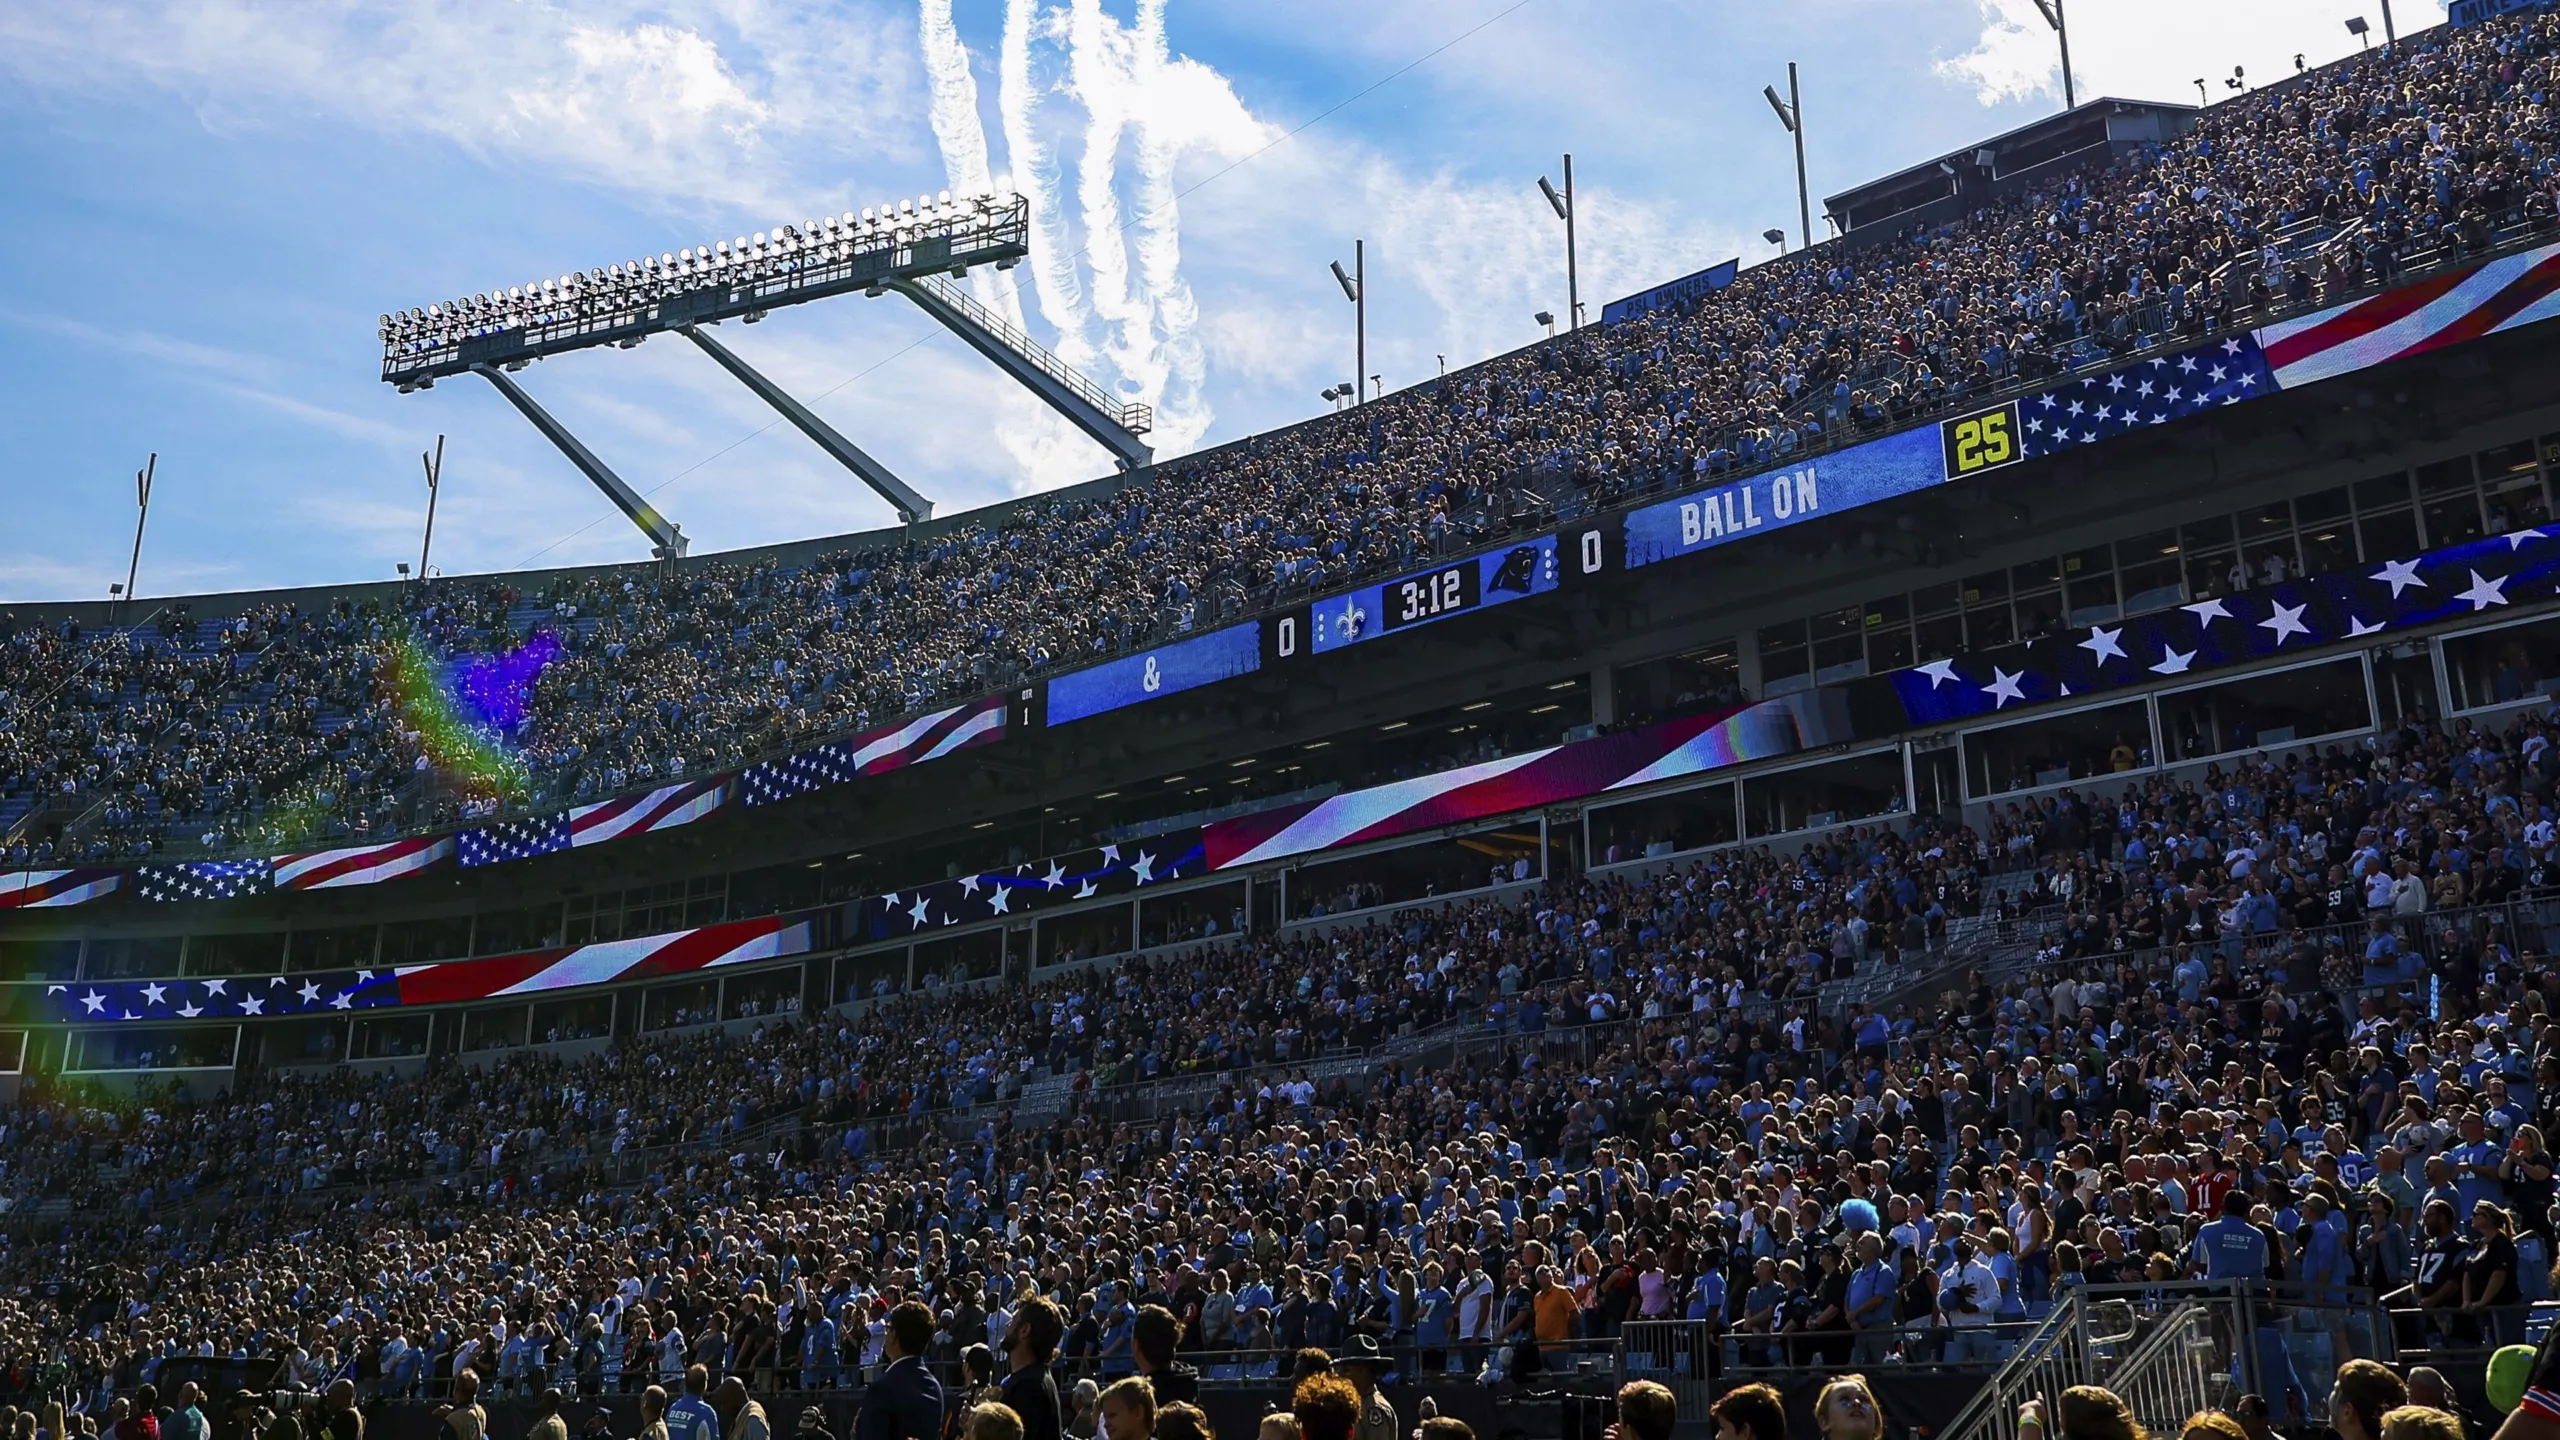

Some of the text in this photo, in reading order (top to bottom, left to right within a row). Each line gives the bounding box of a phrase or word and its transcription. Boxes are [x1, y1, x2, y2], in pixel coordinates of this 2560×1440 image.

[1626, 275, 1710, 316] PSL OWNERS
[1956, 412, 2009, 471] 25
[1680, 468, 1817, 545] BALL ON
[1582, 530, 1601, 573] 0
[1399, 567, 1460, 621] 3:12
[1279, 618, 1295, 657] 0
[1144, 657, 1160, 692] &
[1022, 689, 1032, 700] QTR
[1024, 707, 1028, 725] 1
[2228, 794, 2235, 806] 8
[2530, 830, 2539, 842] 4
[2328, 890, 2342, 907] 59
[2261, 1027, 2283, 1038] NAVY
[2326, 1101, 2346, 1120] 59
[2542, 1094, 2551, 1111] 9
[2196, 1184, 2211, 1210] 11
[2223, 1233, 2252, 1243] BEST
[2417, 1252, 2446, 1284] 17
[1773, 1301, 1786, 1329] 5
[670, 1410, 695, 1421] BEST
